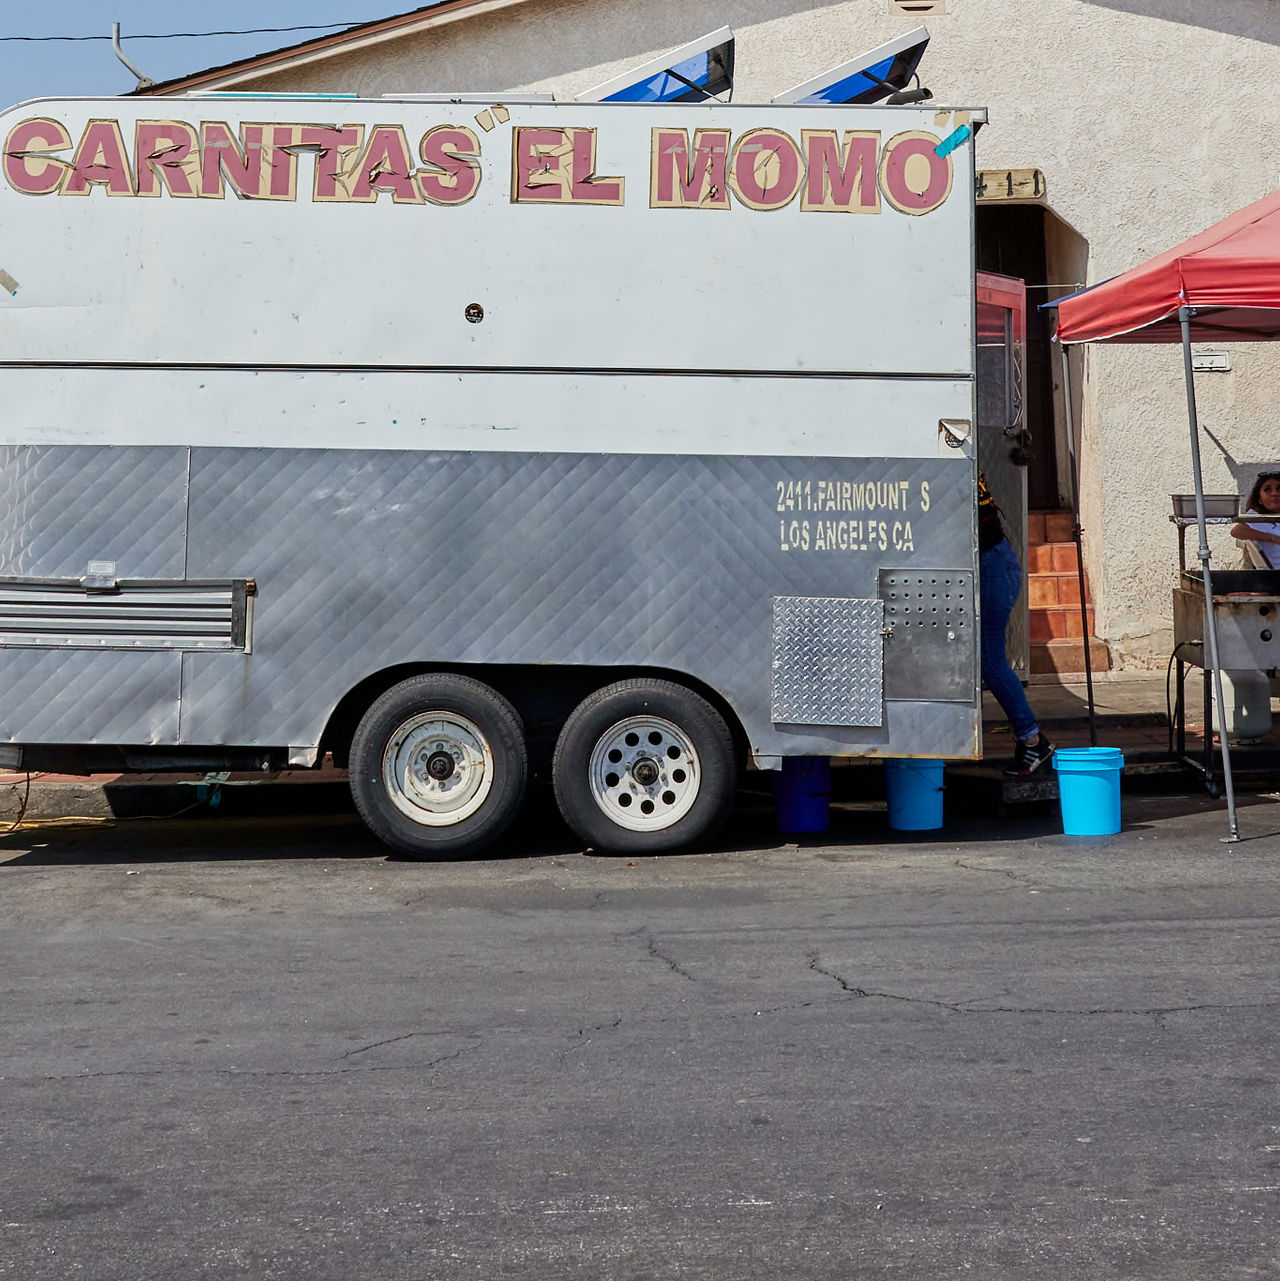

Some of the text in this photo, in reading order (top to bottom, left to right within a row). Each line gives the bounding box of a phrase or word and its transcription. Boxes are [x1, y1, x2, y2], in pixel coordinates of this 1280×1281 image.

[3, 118, 954, 216] CARNITAS EL MOMO
[818, 481, 909, 512] FAIRMOUNT
[920, 480, 930, 512] S
[780, 520, 810, 550] LOS
[892, 521, 915, 551] CA
